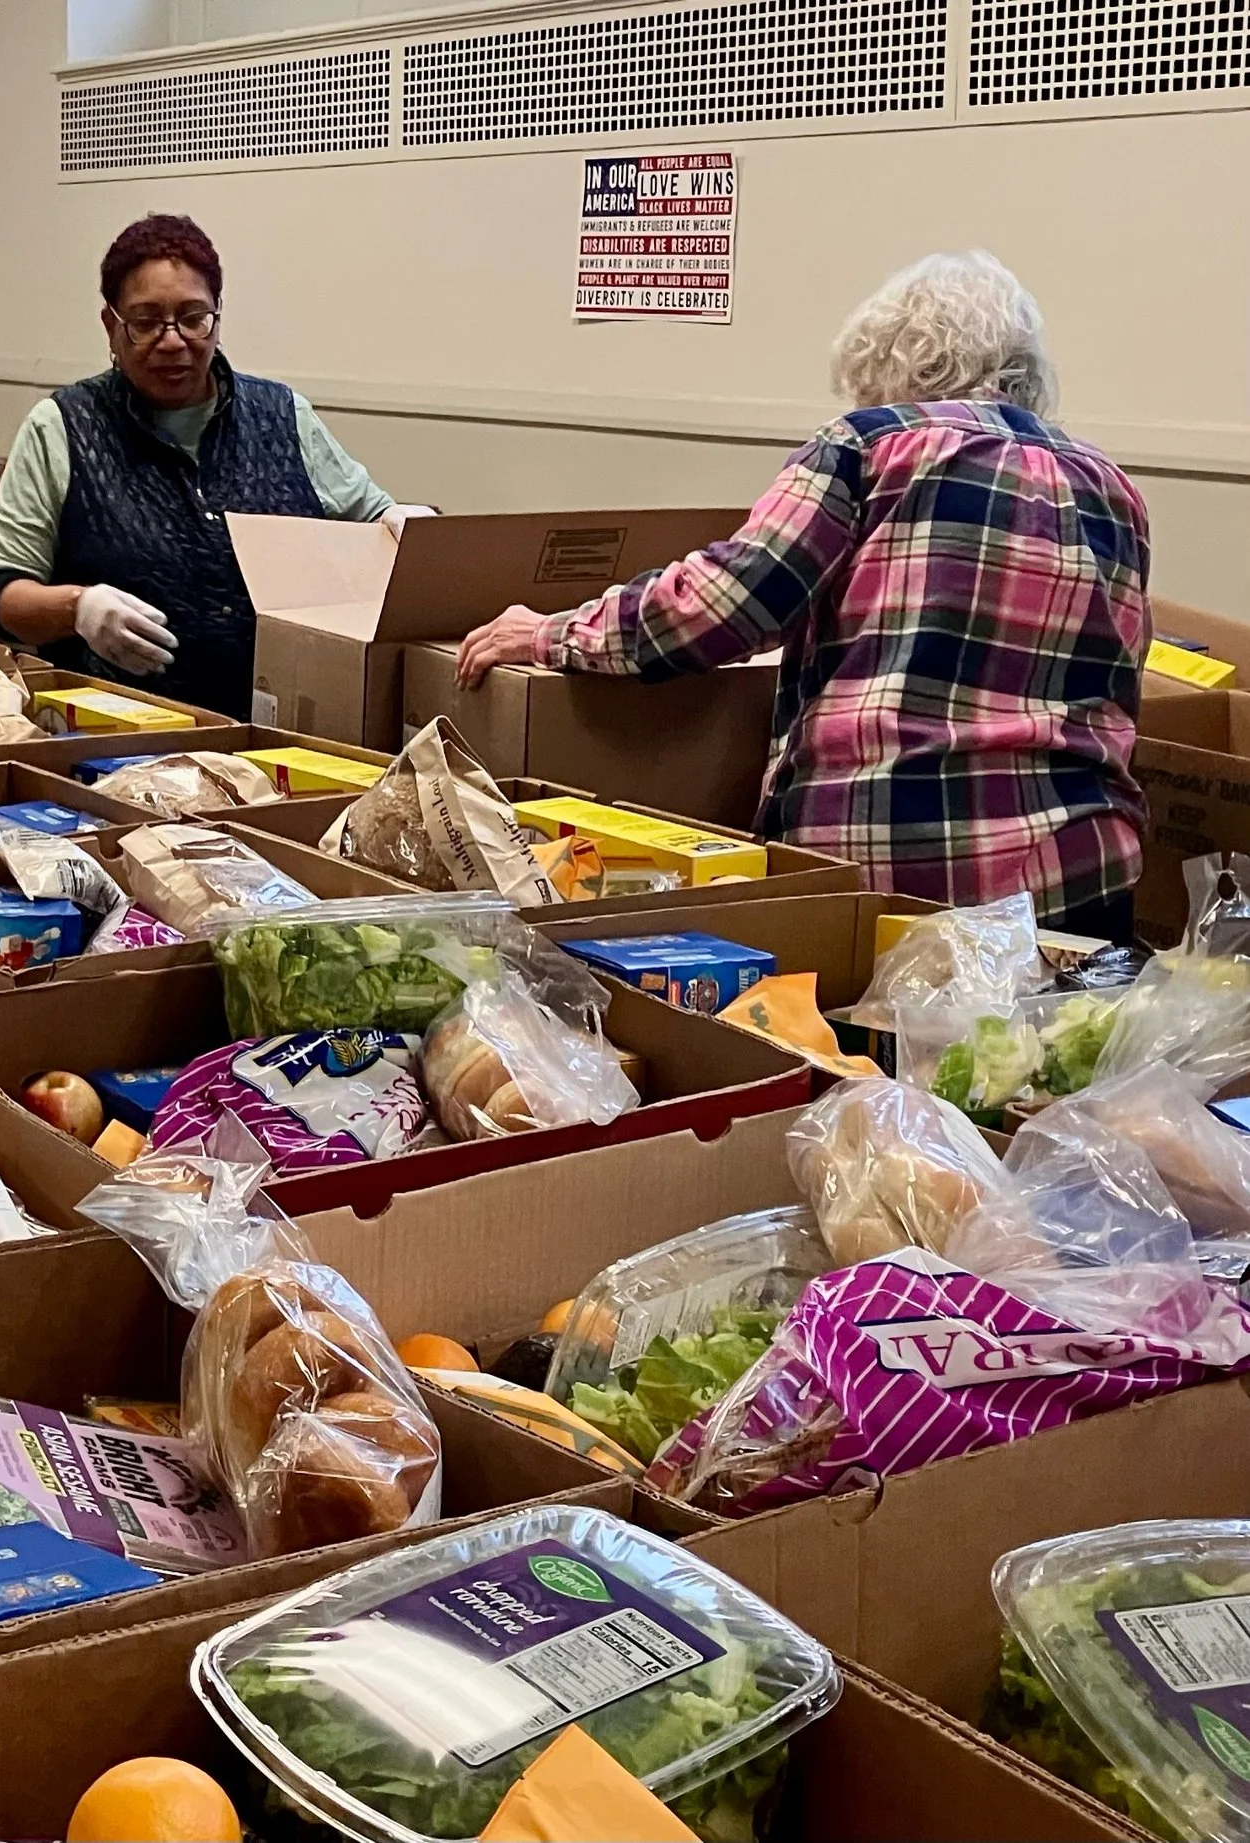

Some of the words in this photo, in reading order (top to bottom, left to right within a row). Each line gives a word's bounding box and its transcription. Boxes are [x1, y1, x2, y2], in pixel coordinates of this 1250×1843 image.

[586, 165, 602, 189] IN
[609, 163, 637, 188] OUR
[640, 158, 654, 170] ALL
[656, 156, 685, 169] PEOPLE
[688, 156, 703, 168] ARE
[706, 154, 730, 168] EQUAL
[640, 173, 680, 197] LOVE
[691, 171, 734, 196] WINS
[584, 192, 636, 213] AMERICA
[639, 201, 664, 214] BLACK
[667, 200, 691, 213] LIVES
[694, 199, 730, 213] MATTER
[580, 219, 628, 232] IMMIGRANTS
[629, 220, 635, 231] &
[637, 219, 674, 232] REFUGEES
[676, 219, 690, 231] ARE
[693, 218, 732, 231] WELCOME
[582, 238, 645, 253] DISABILITIES
[649, 238, 667, 253] ARE
[671, 238, 728, 253] RESPECTED
[579, 258, 604, 269] WOMEN
[608, 258, 622, 269] ARE
[625, 258, 633, 269] IN
[636, 258, 663, 270] CHARGE
[666, 258, 675, 270] OF
[679, 258, 700, 270] THEIR
[703, 258, 730, 270] BODIES
[579, 273, 605, 285] PEOPLE
[607, 274, 612, 285] &
[615, 274, 640, 286] PLANET
[641, 275, 654, 286] ARE
[657, 275, 681, 287] VALUED
[683, 275, 700, 287] OVER
[702, 275, 727, 288] PROFIT
[576, 289, 634, 306] DIVERSITY
[640, 291, 651, 307] IS
[657, 292, 729, 309] CELEBRATED
[439, 806, 479, 882] Multigrain
[38, 1423, 77, 1464] ASIAN
[80, 1435, 119, 1492] FARMS
[94, 1433, 167, 1509] BRIGHT
[55, 1462, 103, 1517] SESAME
[535, 1560, 598, 1598] Organic
[449, 1588, 524, 1635] romaine
[472, 1580, 556, 1626] chopped
[590, 1625, 633, 1657] Calories
[640, 1659, 663, 1676] 15
[624, 1611, 665, 1643] Nutrition
[665, 1635, 695, 1662] Facts
